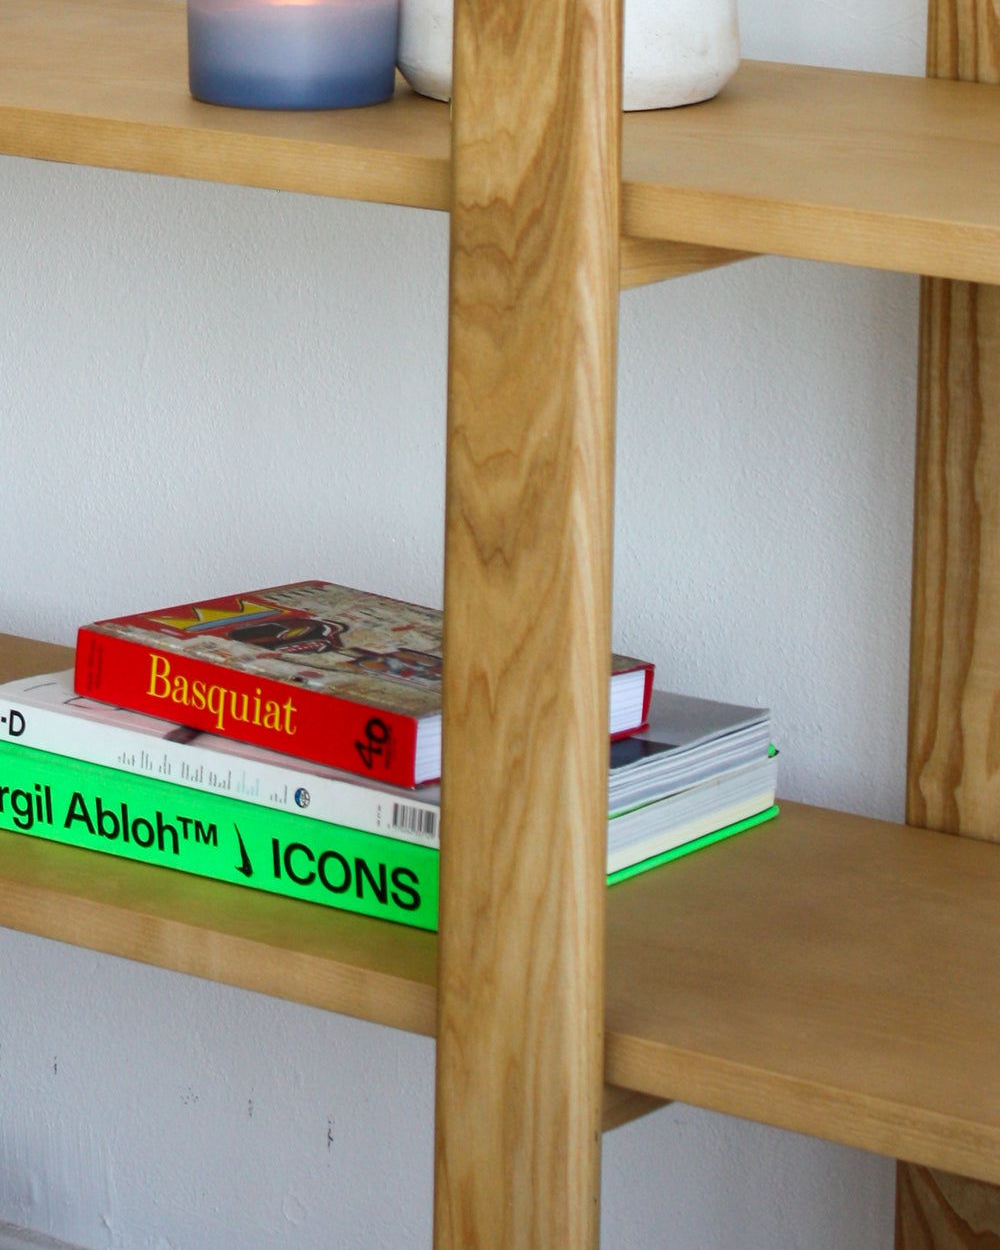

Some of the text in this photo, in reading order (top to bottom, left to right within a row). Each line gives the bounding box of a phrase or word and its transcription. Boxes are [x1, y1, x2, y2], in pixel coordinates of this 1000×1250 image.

[146, 654, 298, 736] Basquiat
[355, 717, 390, 770] 40
[272, 838, 422, 911] ICONS
